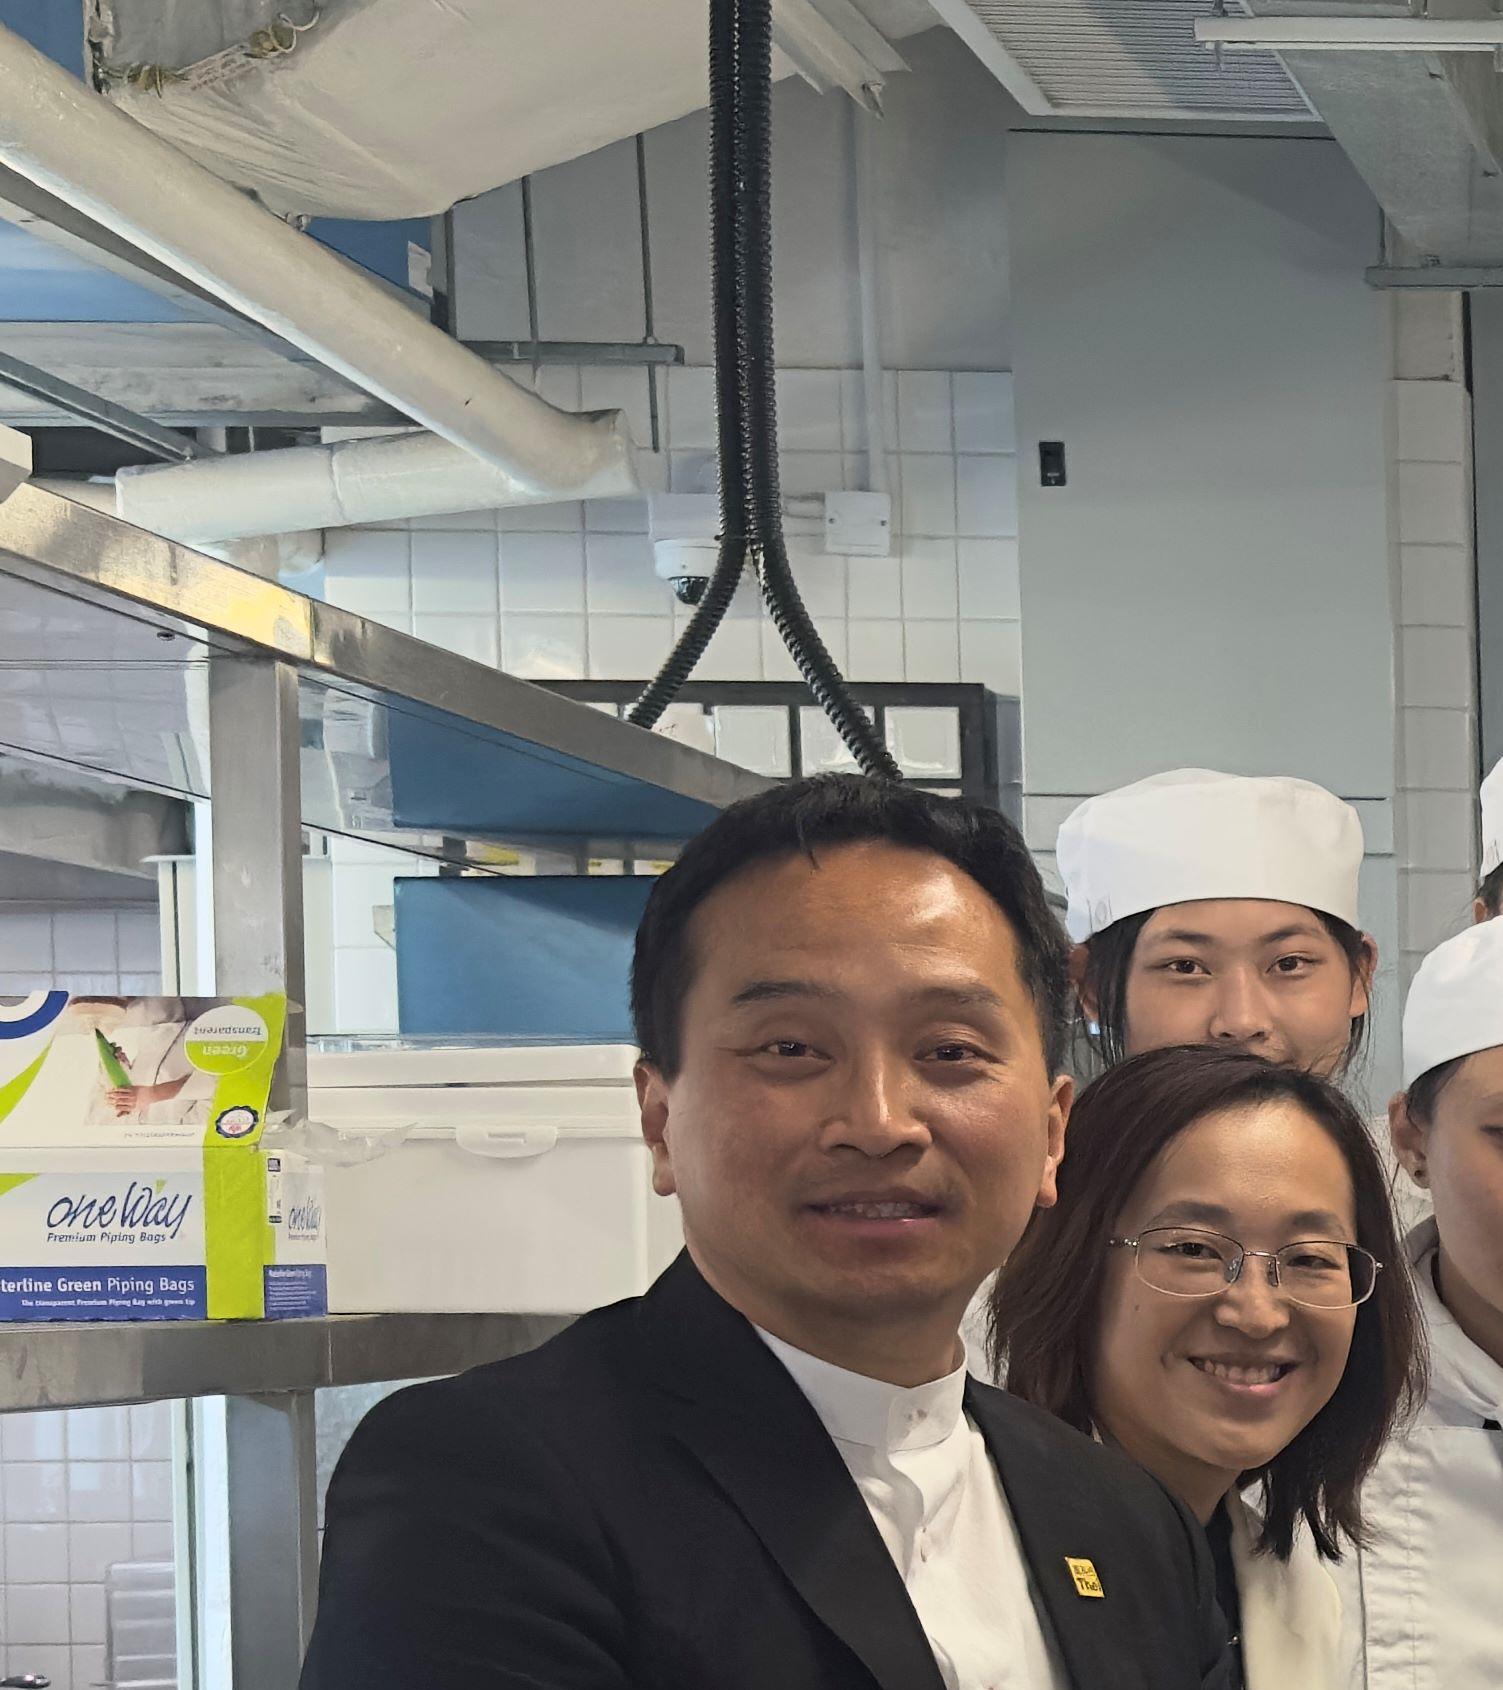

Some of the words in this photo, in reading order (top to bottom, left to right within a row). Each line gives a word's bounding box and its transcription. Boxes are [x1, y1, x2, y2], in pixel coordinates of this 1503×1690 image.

[203, 1044, 249, 1058] Green
[47, 1232, 96, 1242] Premium
[100, 1232, 135, 1244] Piping
[139, 1232, 166, 1244] Bags
[57, 1278, 102, 1292] Green
[107, 1277, 154, 1294] Piping
[160, 1277, 195, 1294] Bags
